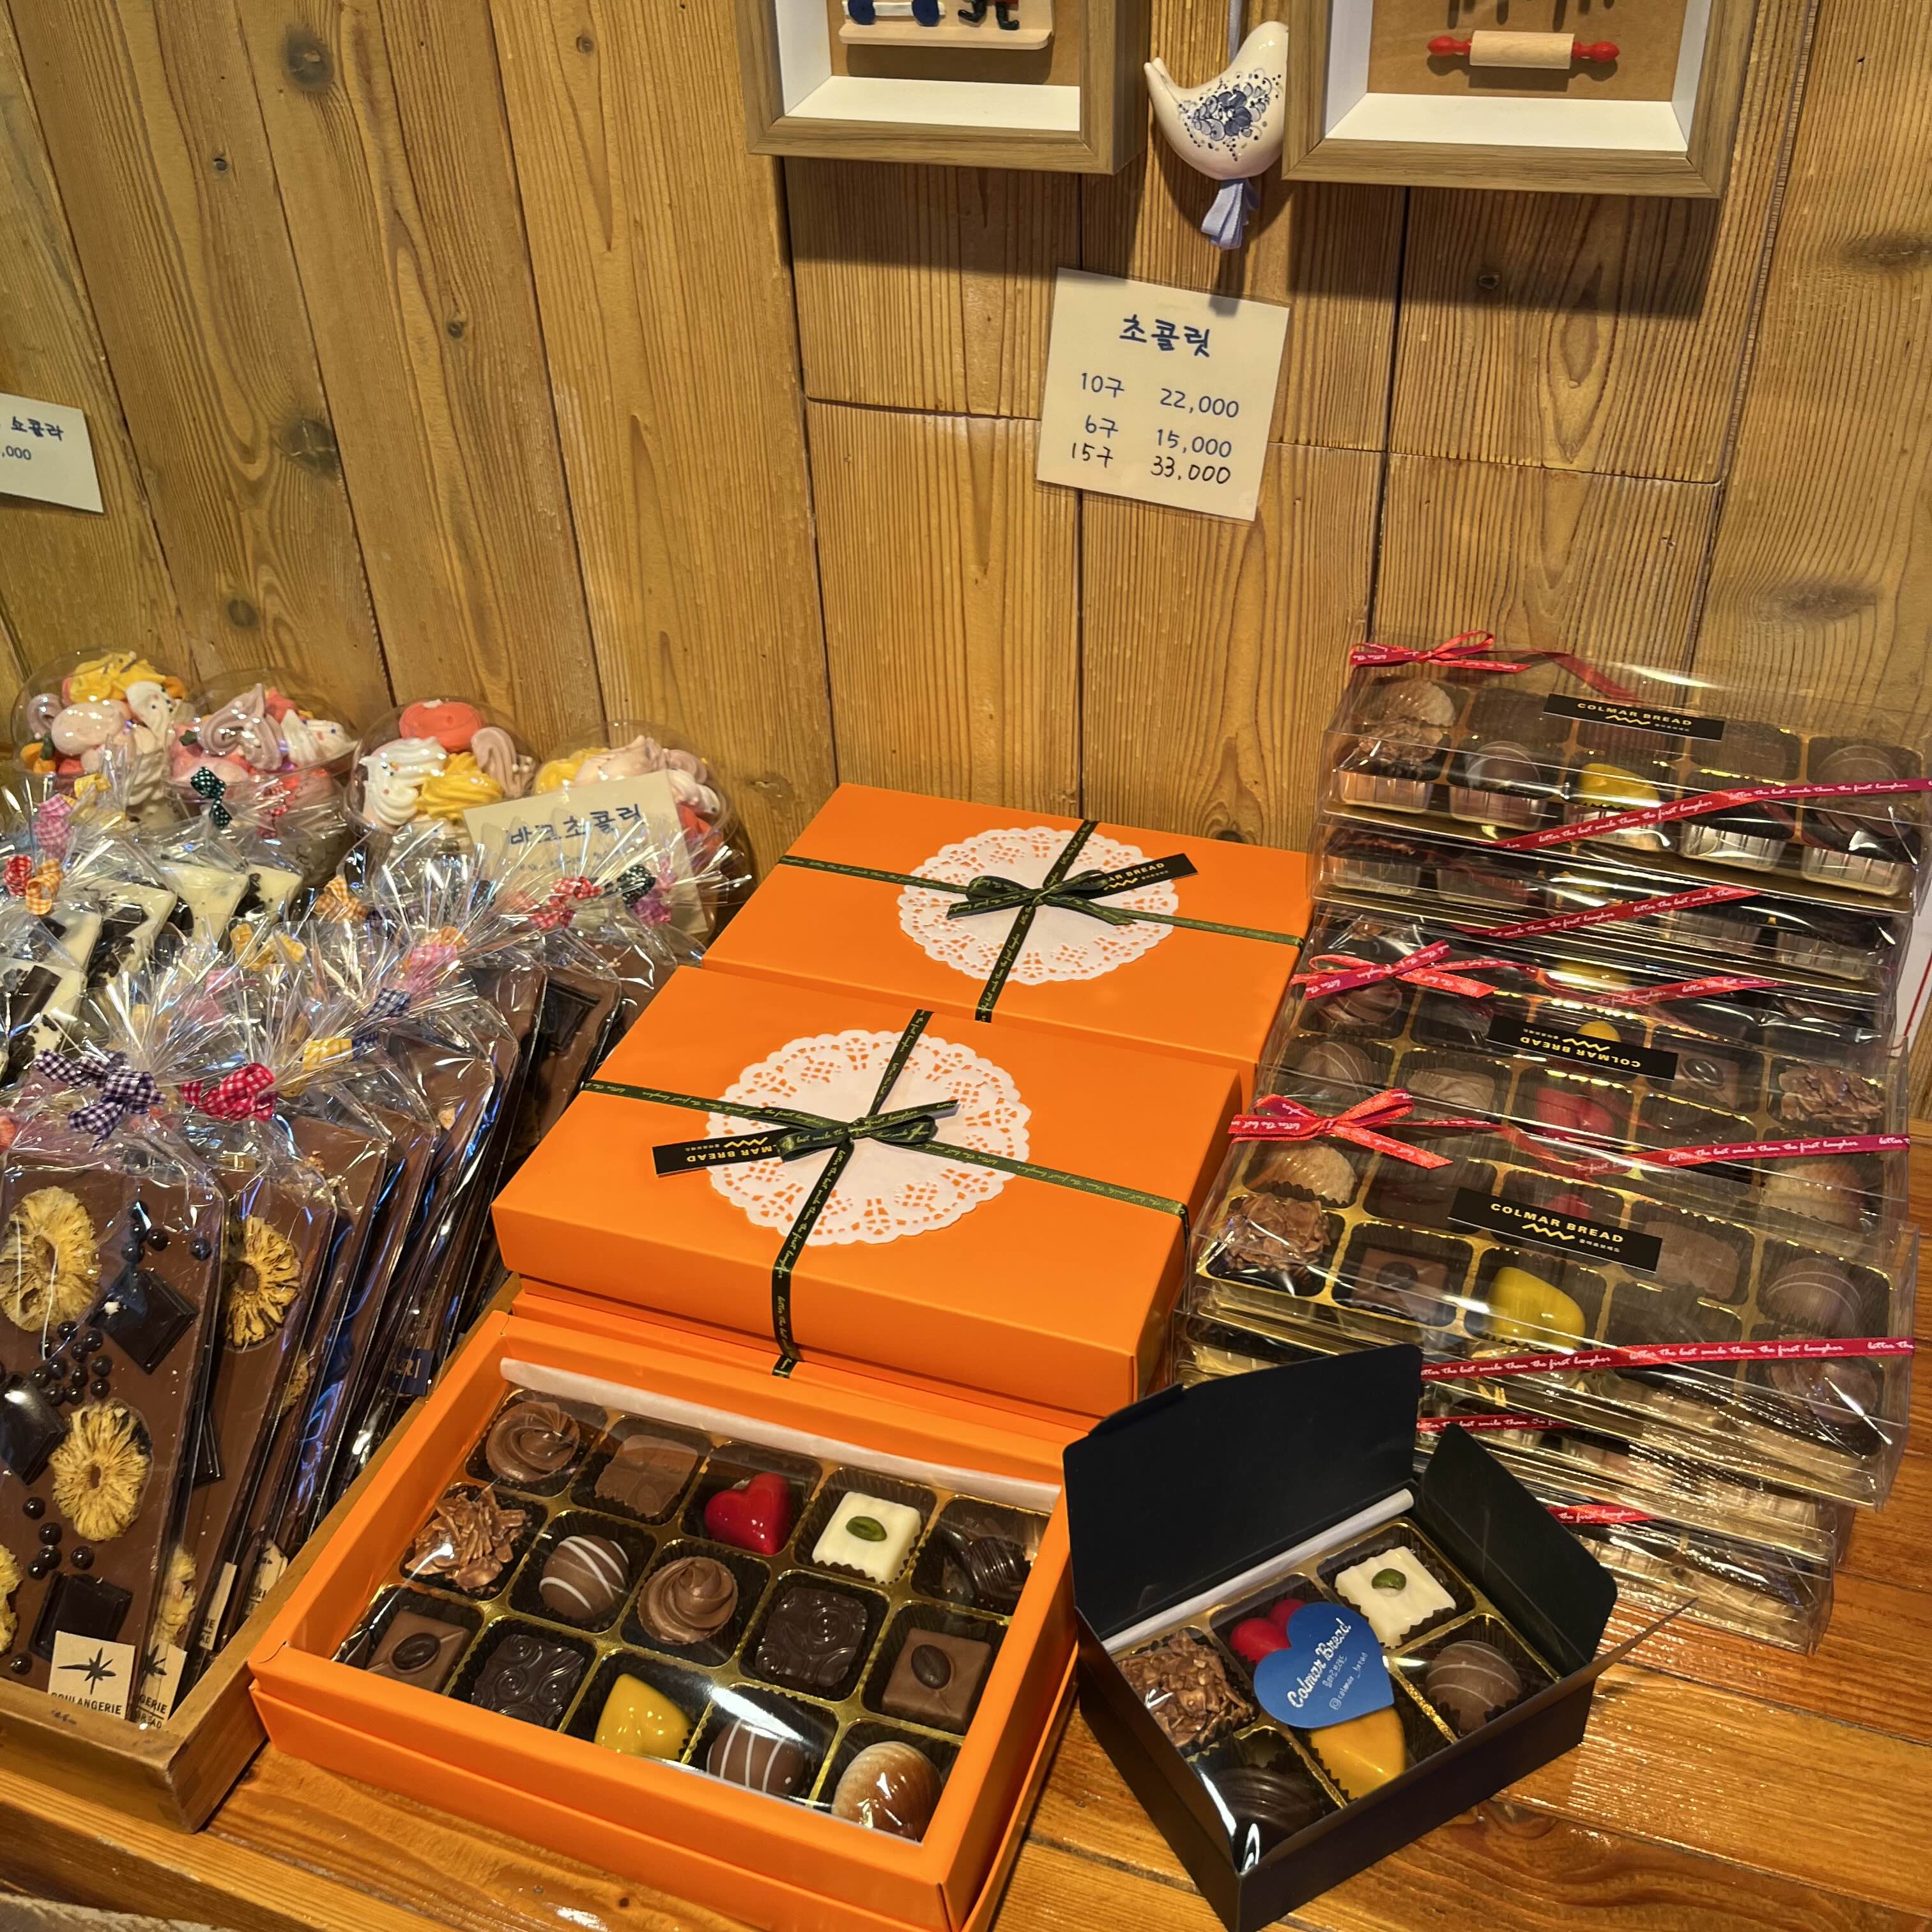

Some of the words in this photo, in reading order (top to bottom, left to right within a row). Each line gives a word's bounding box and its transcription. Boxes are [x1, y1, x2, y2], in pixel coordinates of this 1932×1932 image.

[1120, 314, 1210, 357] 초콜릿
[1081, 372, 1125, 398] 10구
[1160, 387, 1239, 418] 22,000
[1085, 415, 1119, 438] 6구
[1157, 429, 1232, 457] 15,000
[1071, 442, 1114, 468] 15구
[1150, 456, 1231, 484] 33,000
[1577, 703, 1637, 717] COLMAR
[1643, 713, 1692, 726] BREAD
[1125, 862, 1165, 877] BREAD
[1519, 1036, 1571, 1054] BREAD
[1576, 1048, 1641, 1068] COLMAR
[686, 1151, 736, 1162] BREAD
[742, 1145, 773, 1157] MAR
[1490, 1203, 1561, 1228] COLMAR
[1565, 1222, 1625, 1243] BREAD
[1287, 1659, 1326, 1708] Colmar
[1315, 1617, 1351, 1661] Bread
